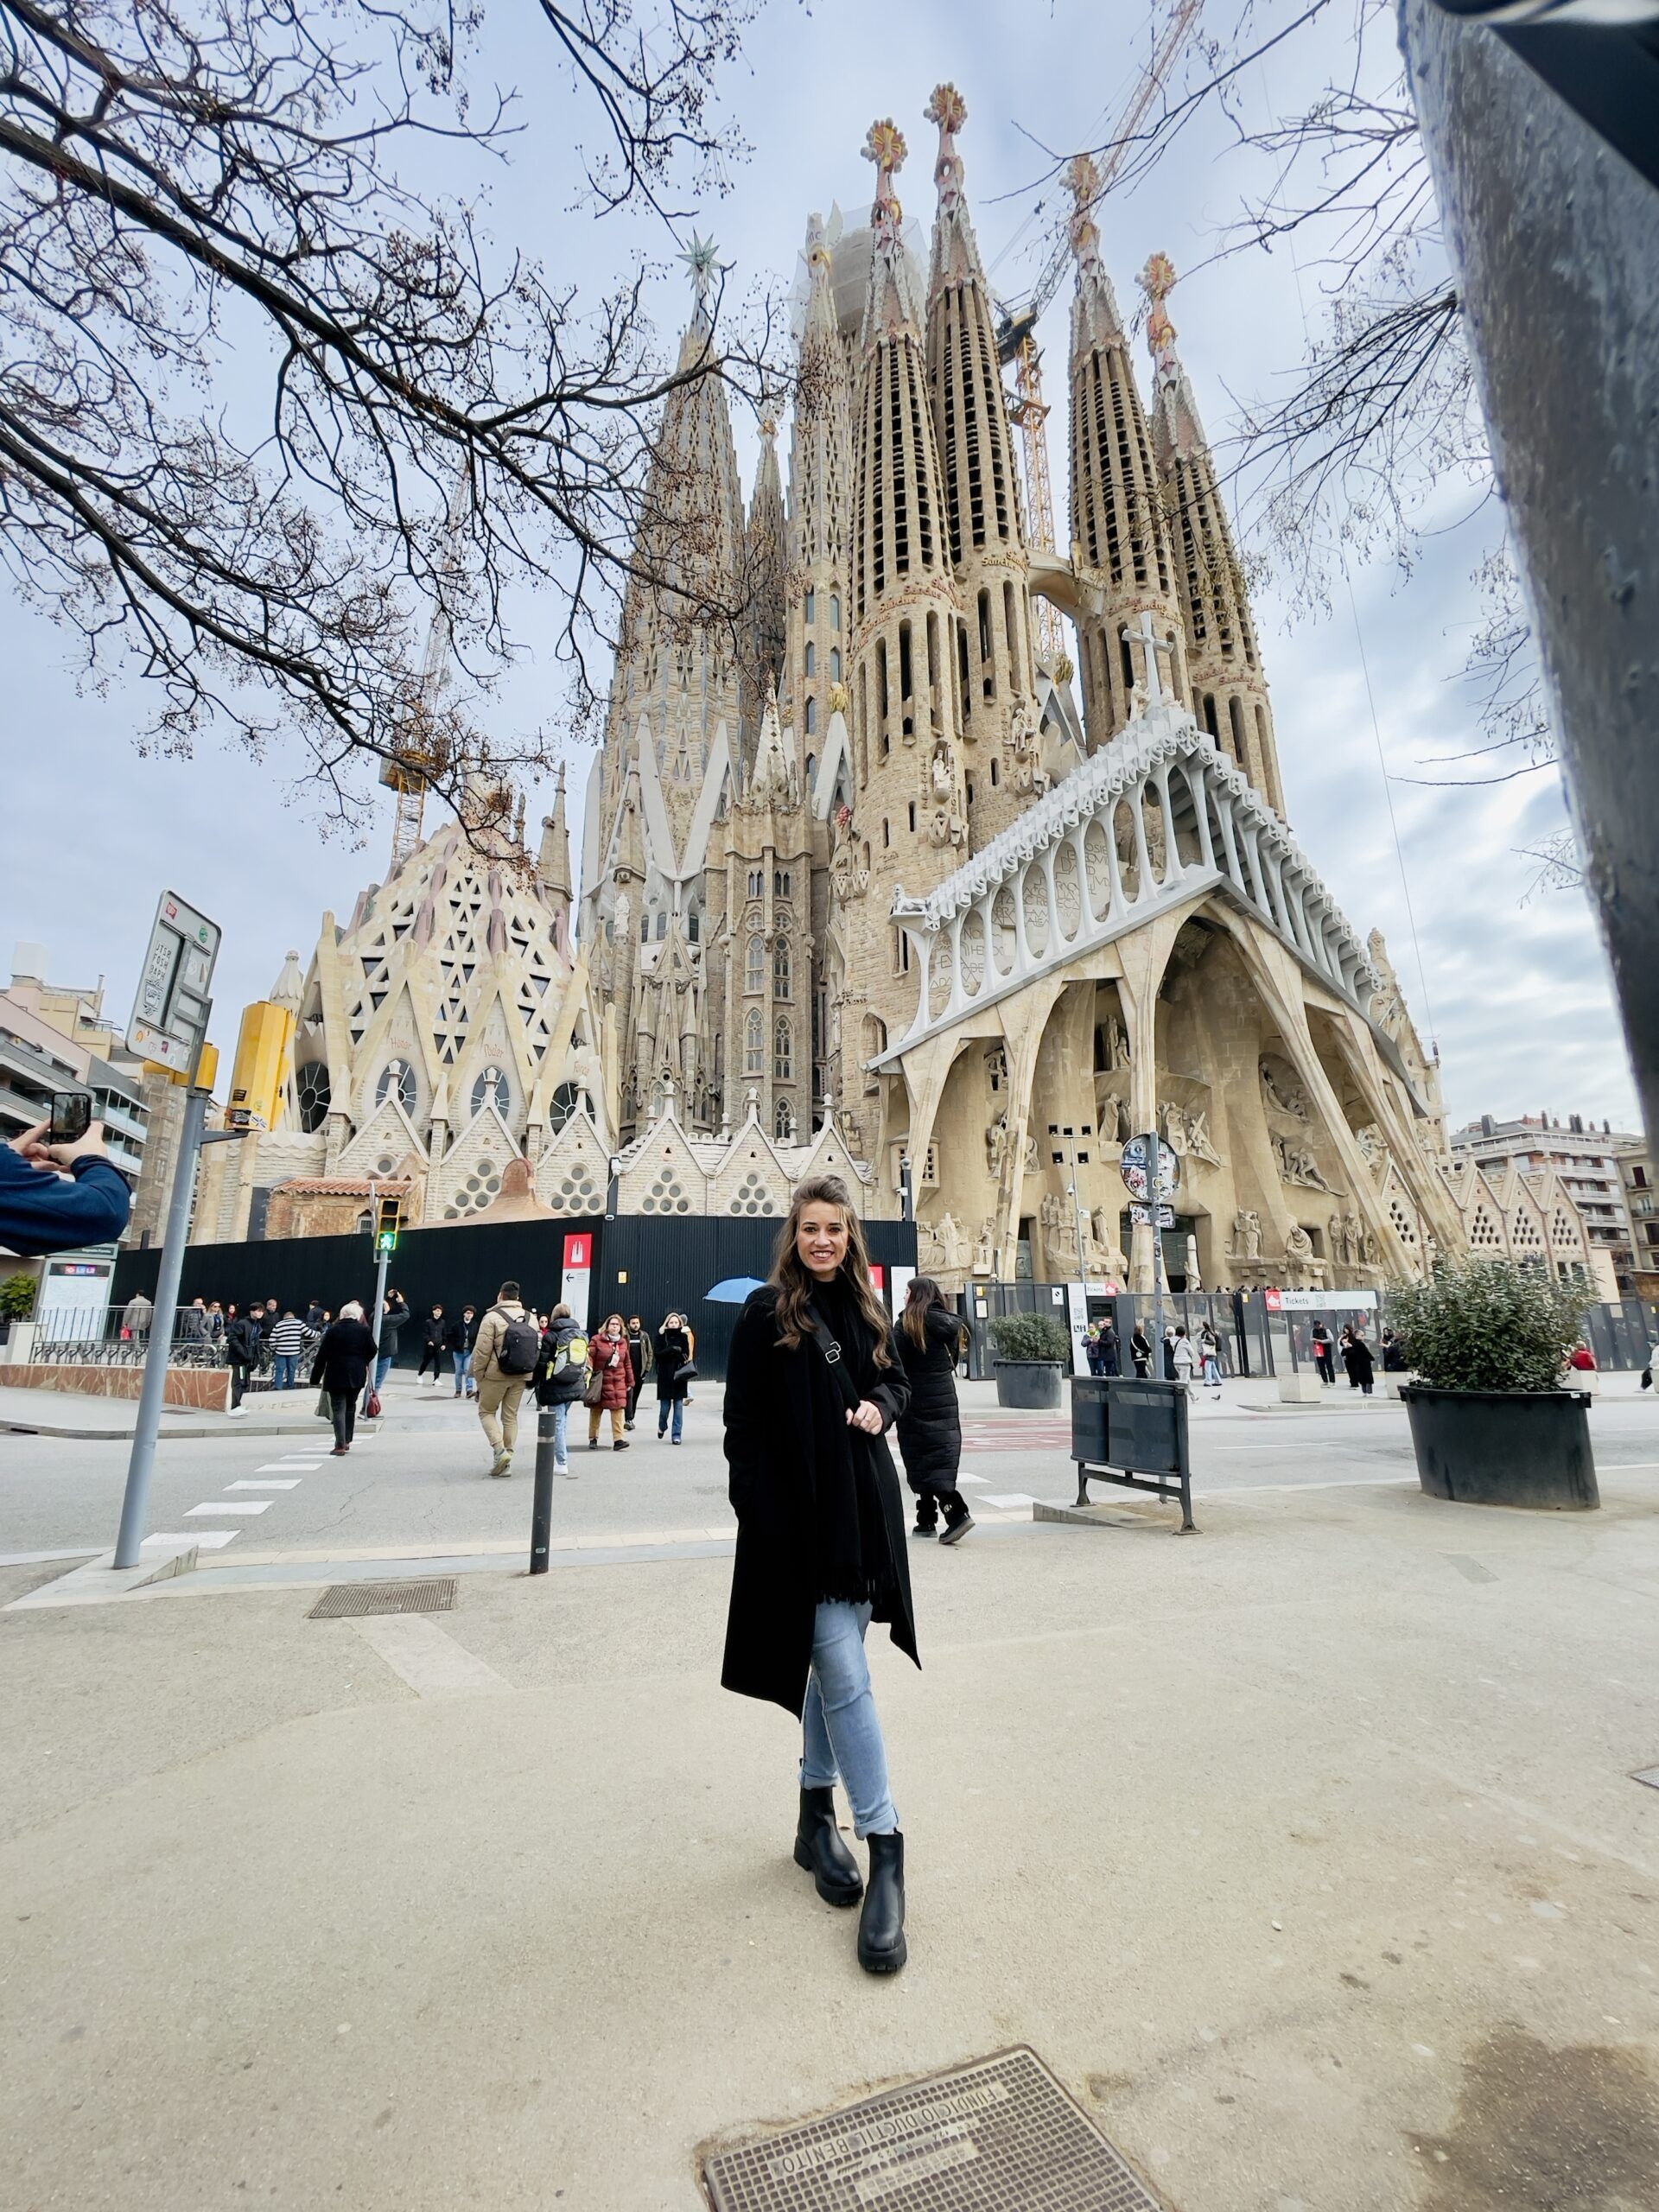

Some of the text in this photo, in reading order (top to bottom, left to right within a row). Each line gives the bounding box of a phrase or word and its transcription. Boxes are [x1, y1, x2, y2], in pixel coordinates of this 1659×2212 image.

[1284, 1297, 1310, 1306] Tickets
[781, 2086, 997, 2174] FUNDICIO DUCTIL BENITO
